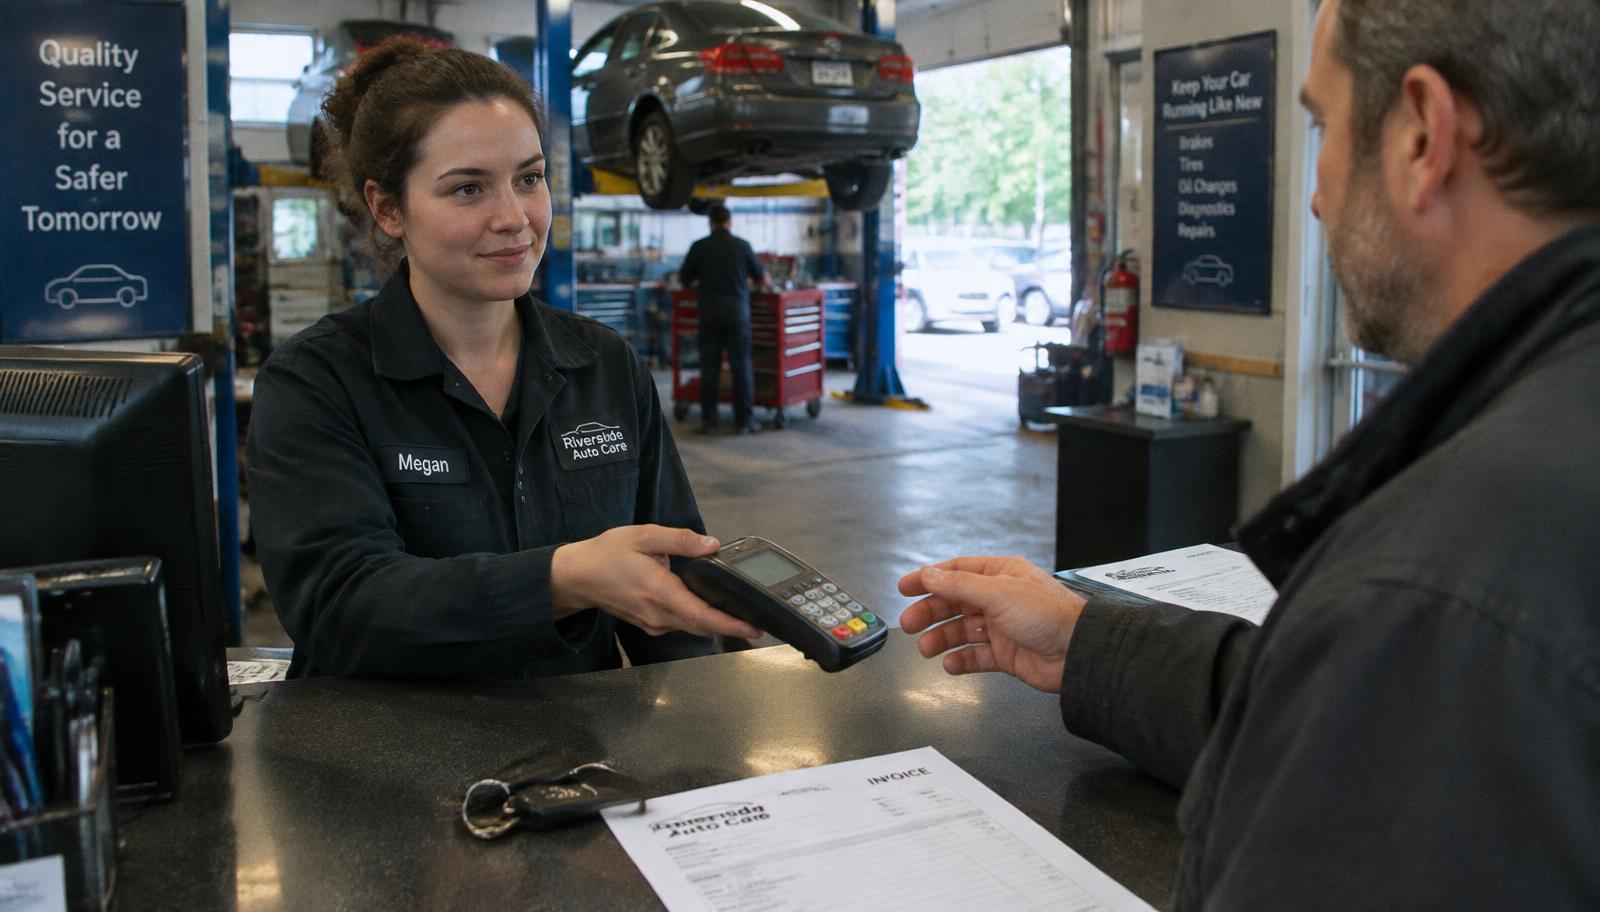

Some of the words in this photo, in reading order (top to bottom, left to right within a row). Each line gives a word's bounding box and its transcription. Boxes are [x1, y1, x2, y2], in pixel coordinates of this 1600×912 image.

[39, 39, 139, 74] Quality
[39, 81, 142, 109] Service
[1172, 81, 1201, 98] Keep
[1202, 75, 1229, 92] Your
[1231, 71, 1252, 88] Car
[1163, 101, 1208, 119] Running
[1209, 96, 1233, 114] Like
[1235, 94, 1263, 112] New
[57, 122, 98, 150] for
[105, 130, 121, 150] a
[1179, 135, 1214, 151] Brakes
[1179, 156, 1204, 171] Tires
[55, 164, 128, 191] Safer
[1178, 178, 1193, 194] Oil
[1194, 178, 1238, 197] Changes
[21, 206, 162, 232] Tomorrow
[1178, 200, 1236, 219] Diagnostics
[1178, 221, 1216, 241] Repairs
[398, 453, 450, 476] Megan
[573, 448, 599, 461] Auto
